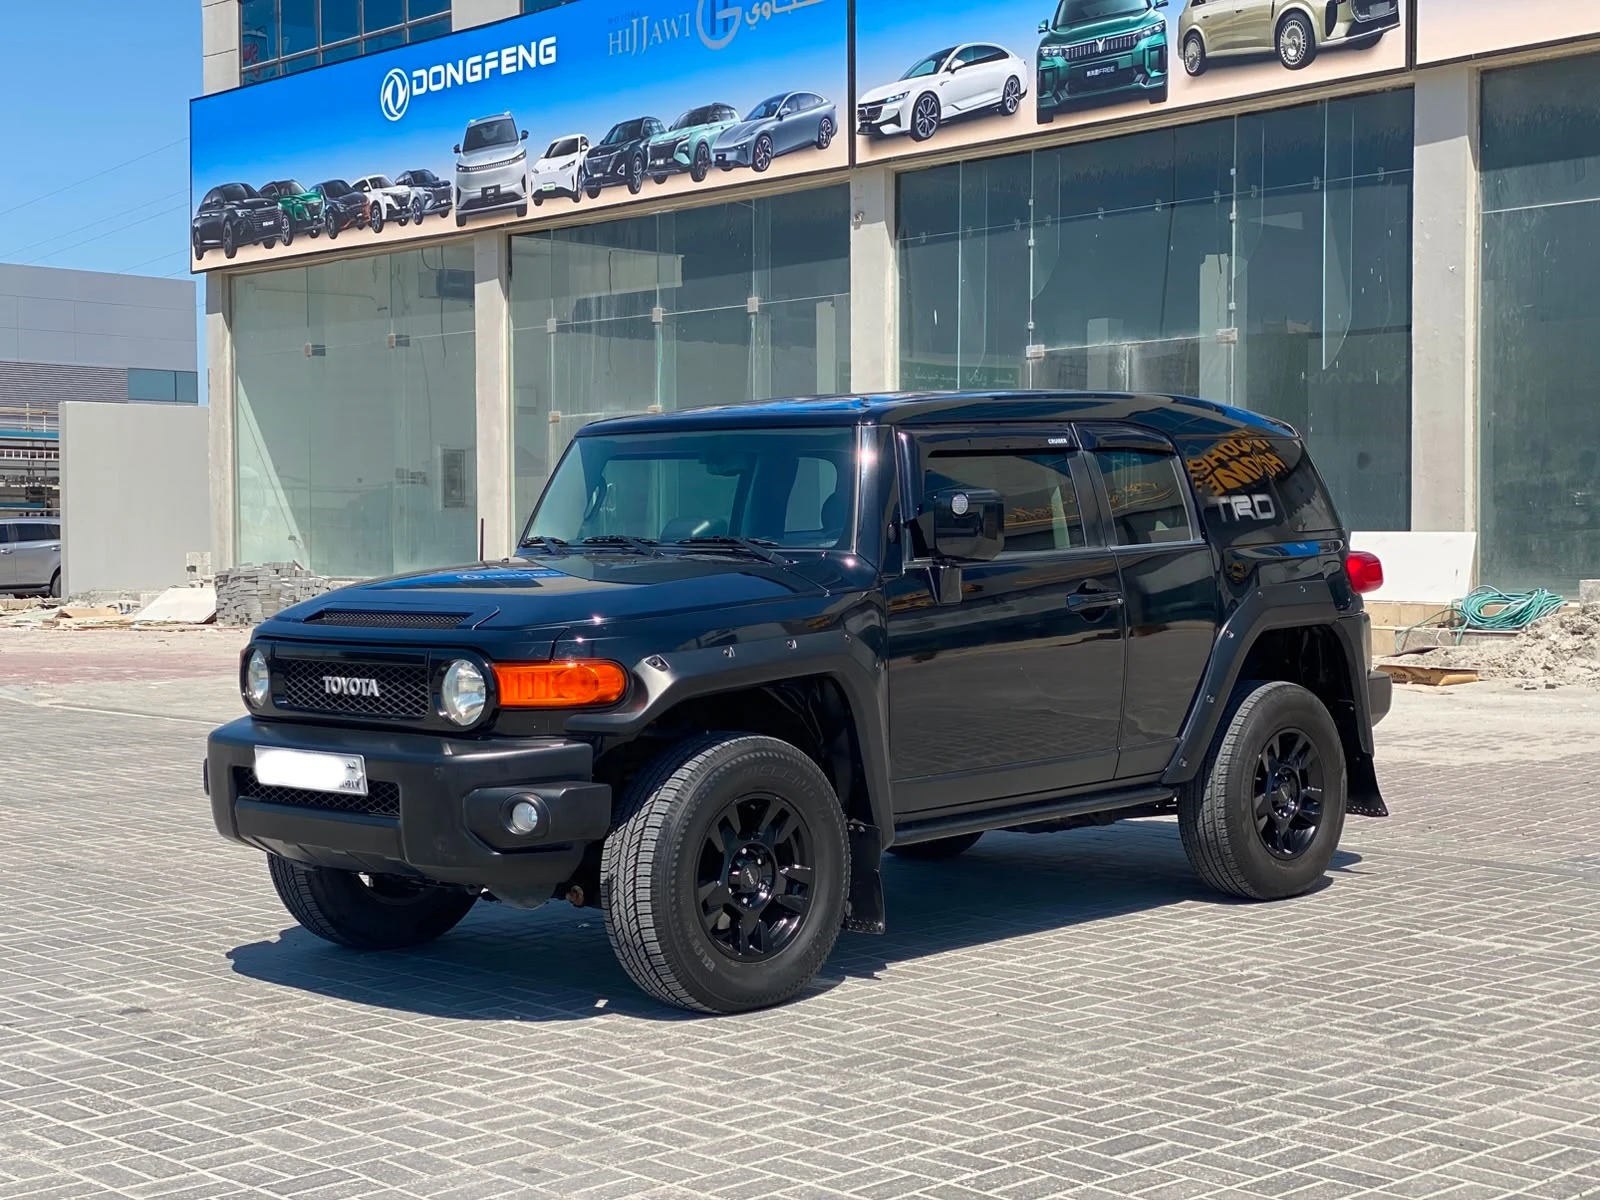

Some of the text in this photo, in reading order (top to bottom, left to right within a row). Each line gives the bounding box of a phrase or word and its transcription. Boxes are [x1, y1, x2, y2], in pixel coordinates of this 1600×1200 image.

[608, 13, 691, 56] HIJJAWI
[412, 36, 557, 96] DONGFENG
[1205, 494, 1276, 523] TRD
[322, 675, 380, 697] TOYOTA
